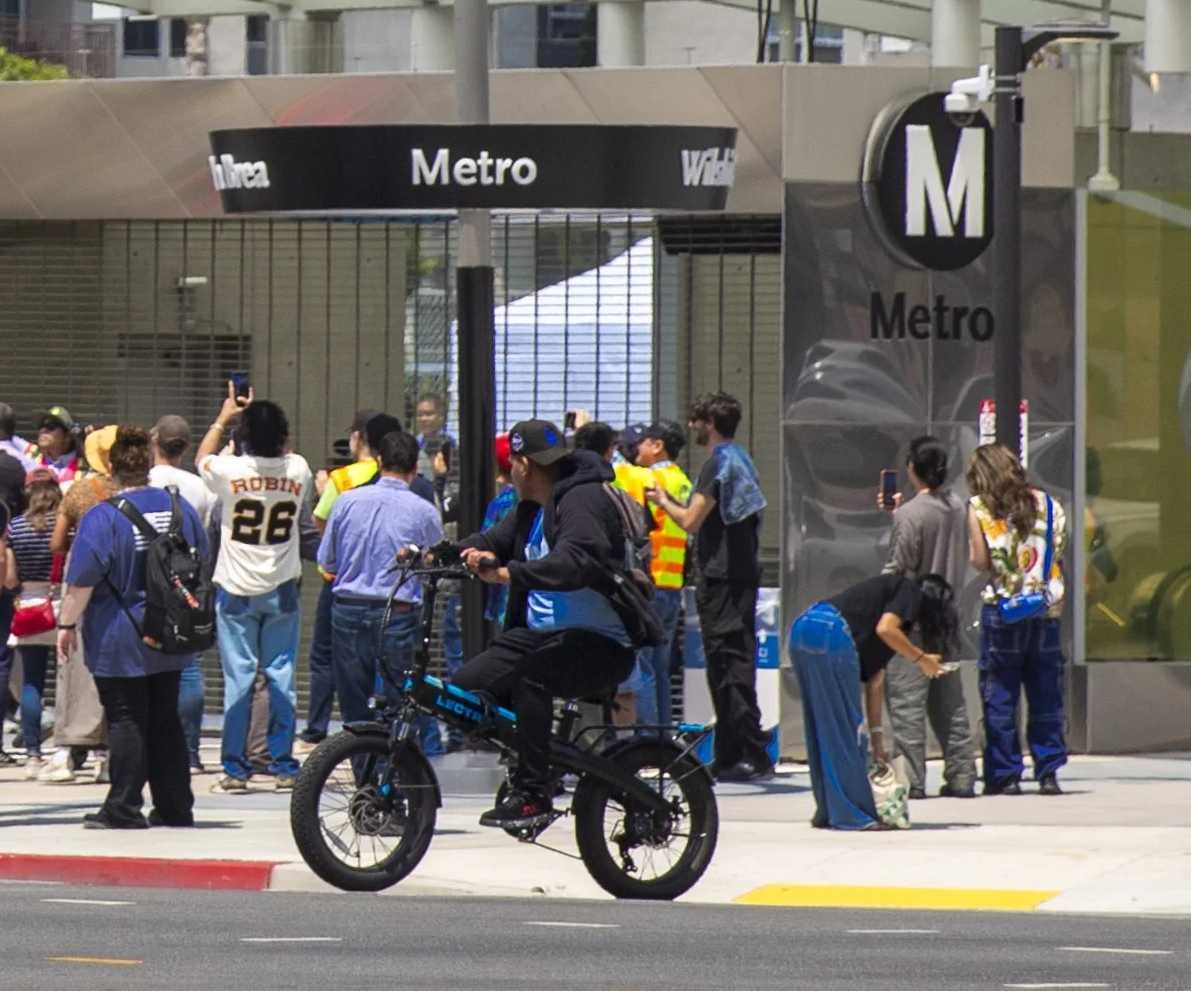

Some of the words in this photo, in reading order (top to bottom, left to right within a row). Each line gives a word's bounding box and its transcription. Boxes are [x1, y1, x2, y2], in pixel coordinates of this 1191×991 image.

[411, 148, 538, 186] Metro
[905, 124, 986, 238] M
[870, 291, 995, 342] Metro
[231, 476, 302, 497] ROBIN
[231, 498, 297, 545] 26
